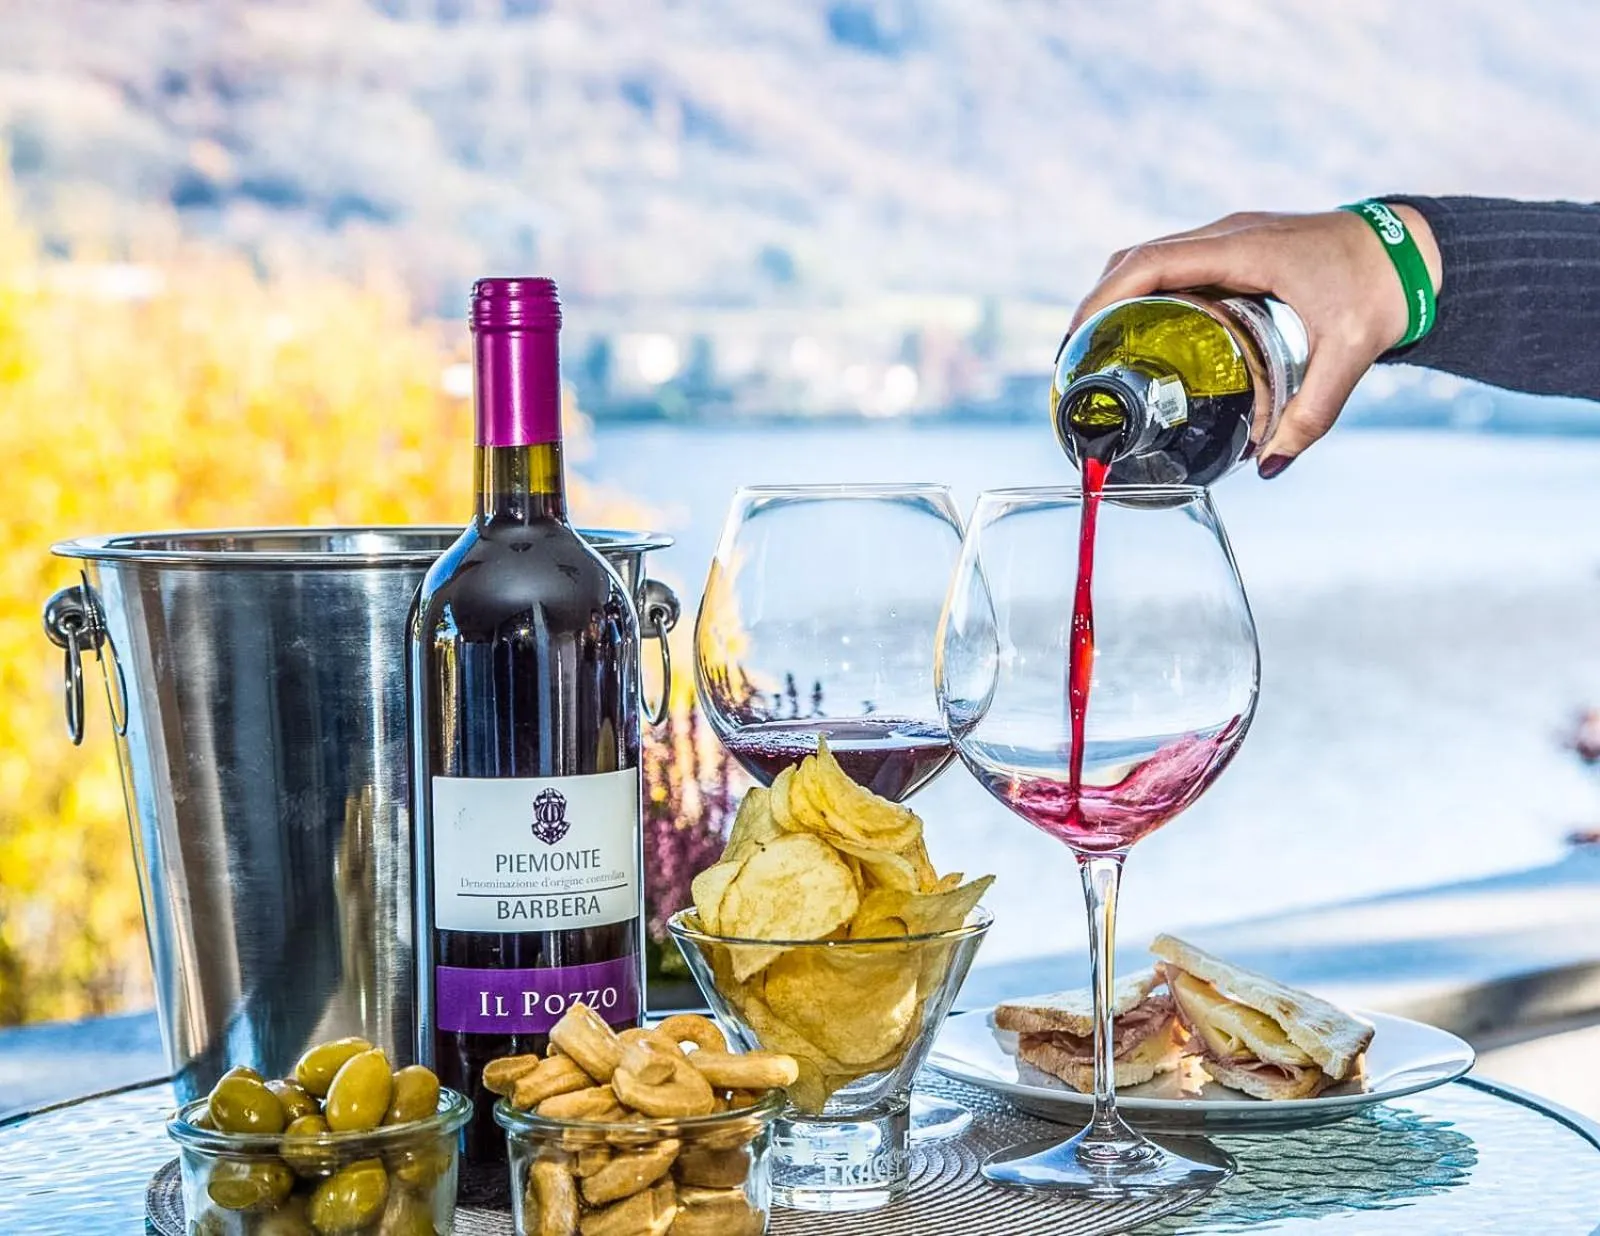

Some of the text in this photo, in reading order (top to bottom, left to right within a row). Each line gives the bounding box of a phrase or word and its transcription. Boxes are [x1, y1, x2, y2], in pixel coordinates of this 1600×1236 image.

[496, 849, 601, 873] PIEMONTE
[460, 877, 539, 889] Denominazione
[541, 875, 585, 889] d'origine
[497, 896, 601, 919] BARBERA
